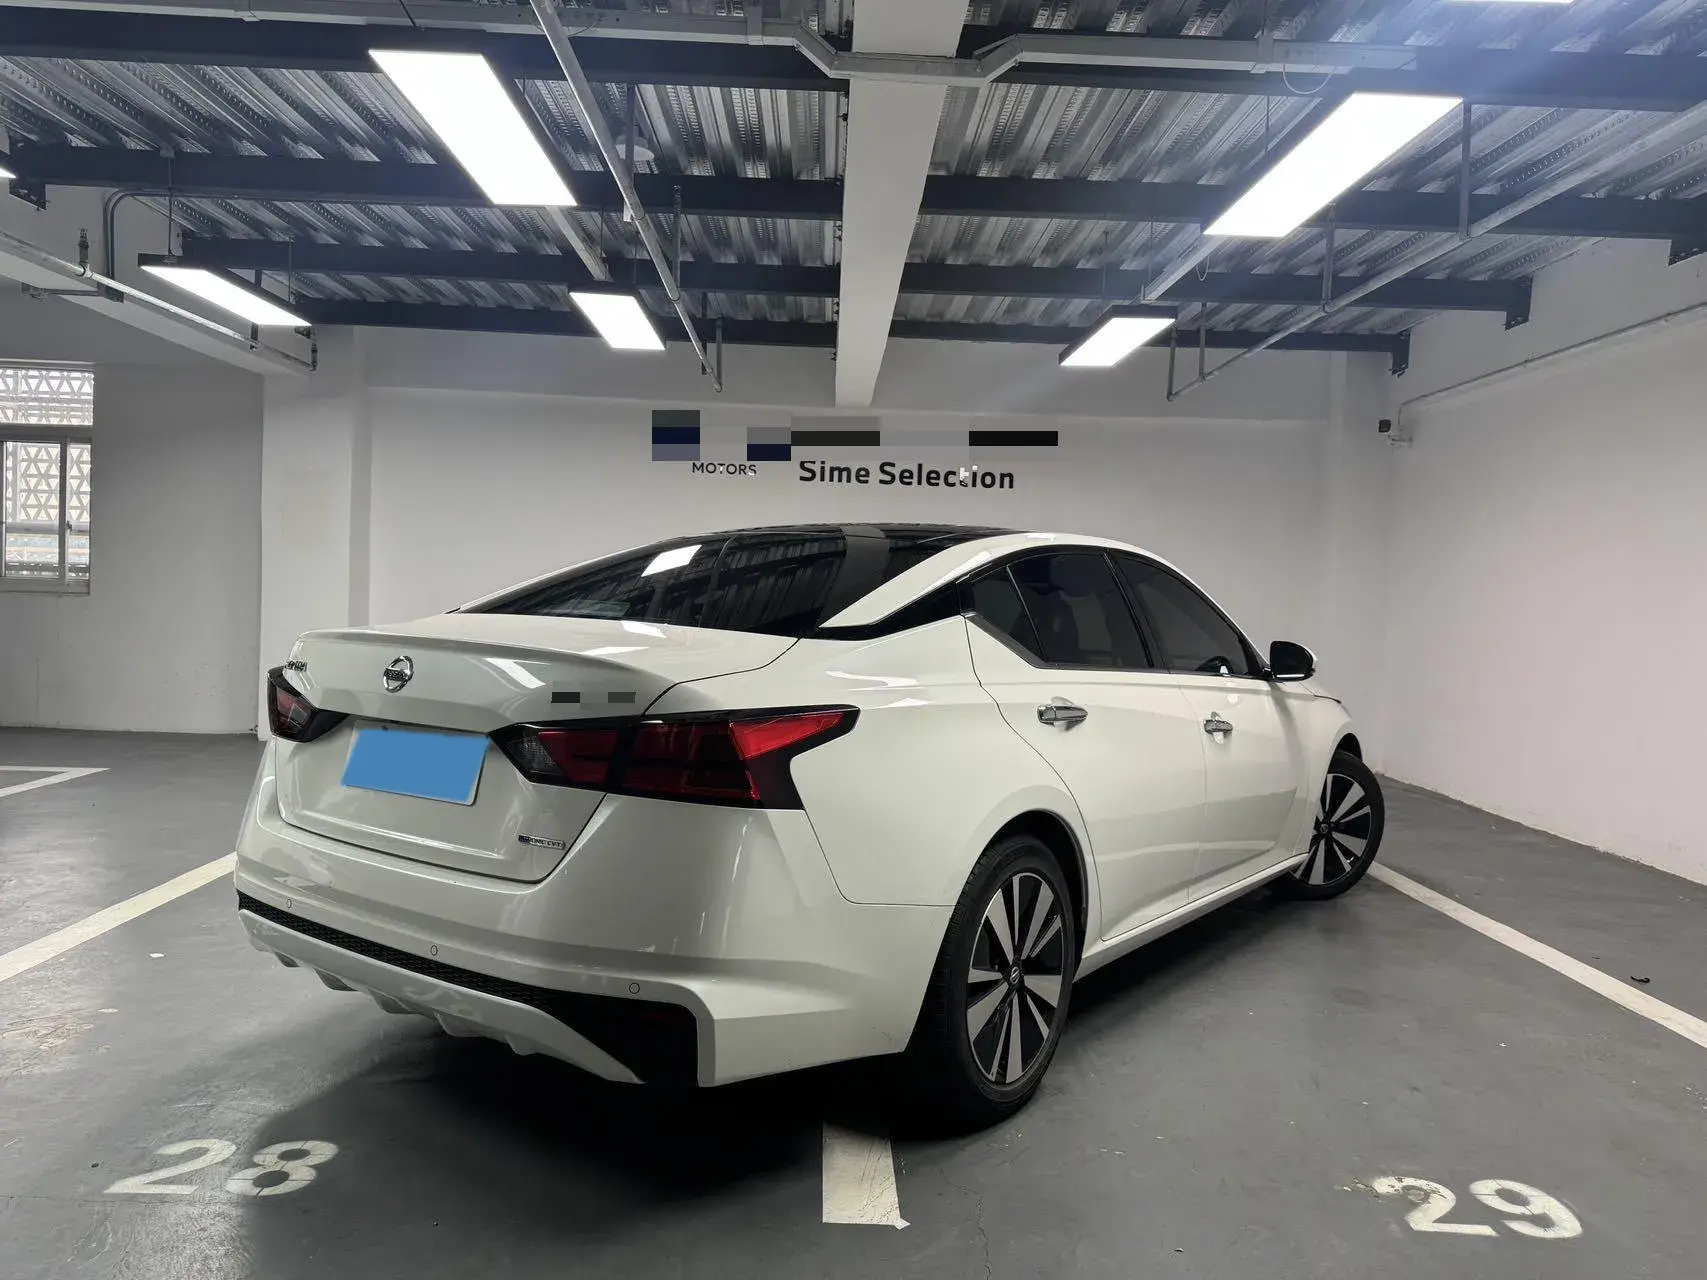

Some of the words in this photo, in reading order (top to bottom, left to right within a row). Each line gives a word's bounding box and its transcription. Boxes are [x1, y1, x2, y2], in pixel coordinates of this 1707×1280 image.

[692, 461, 757, 475] MOTORS
[799, 460, 871, 485] Sime
[878, 461, 1015, 489] Selection
[103, 1138, 340, 1196] 28
[1371, 1176, 1583, 1238] 29
